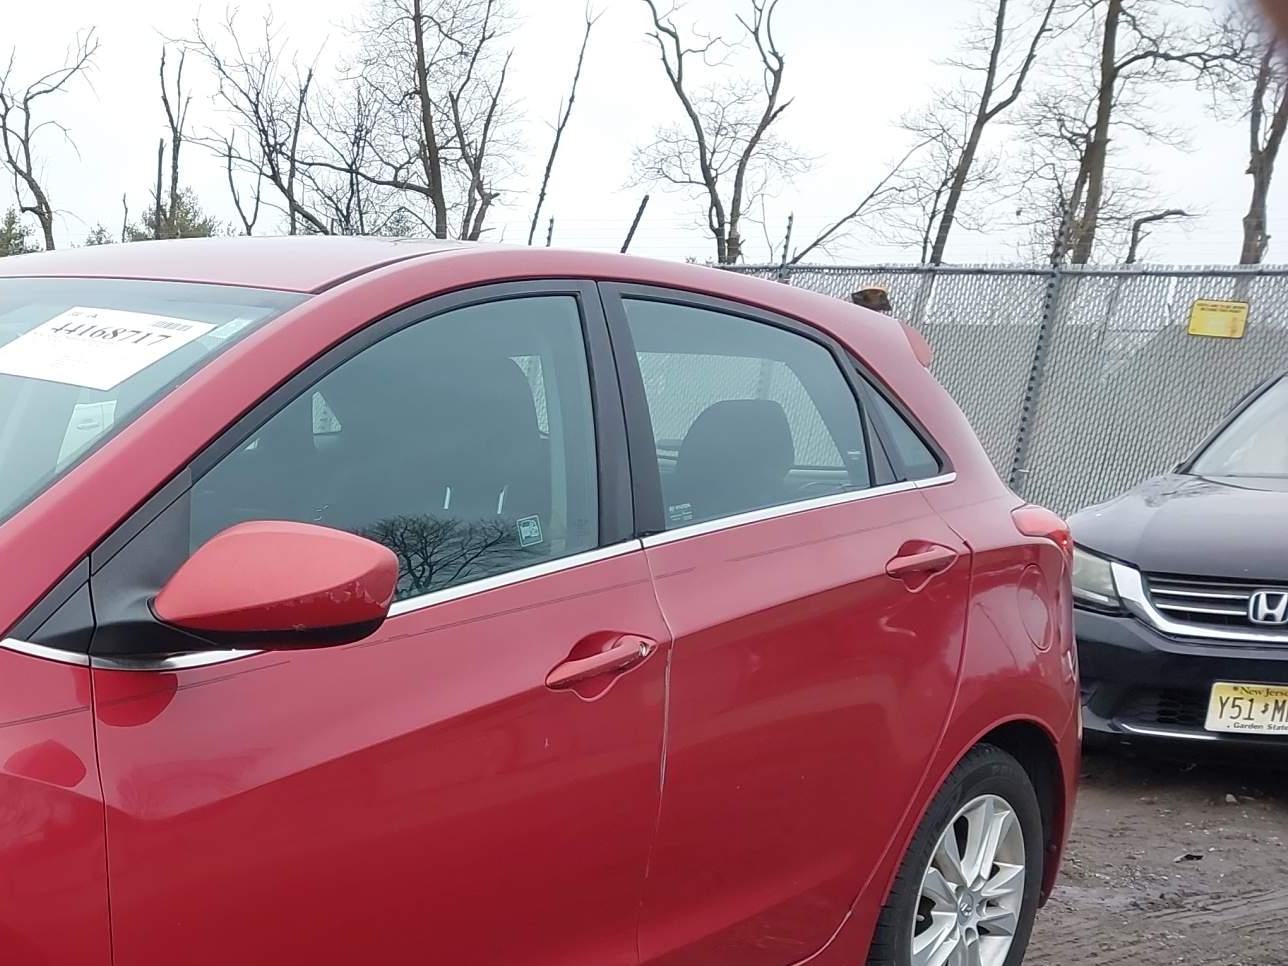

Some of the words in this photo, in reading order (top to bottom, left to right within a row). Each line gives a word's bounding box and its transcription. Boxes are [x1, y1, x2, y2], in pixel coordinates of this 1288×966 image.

[51, 322, 172, 345] 44168717
[1240, 686, 1262, 695] New
[1218, 695, 1255, 721] Y51
[1271, 699, 1288, 723] M
